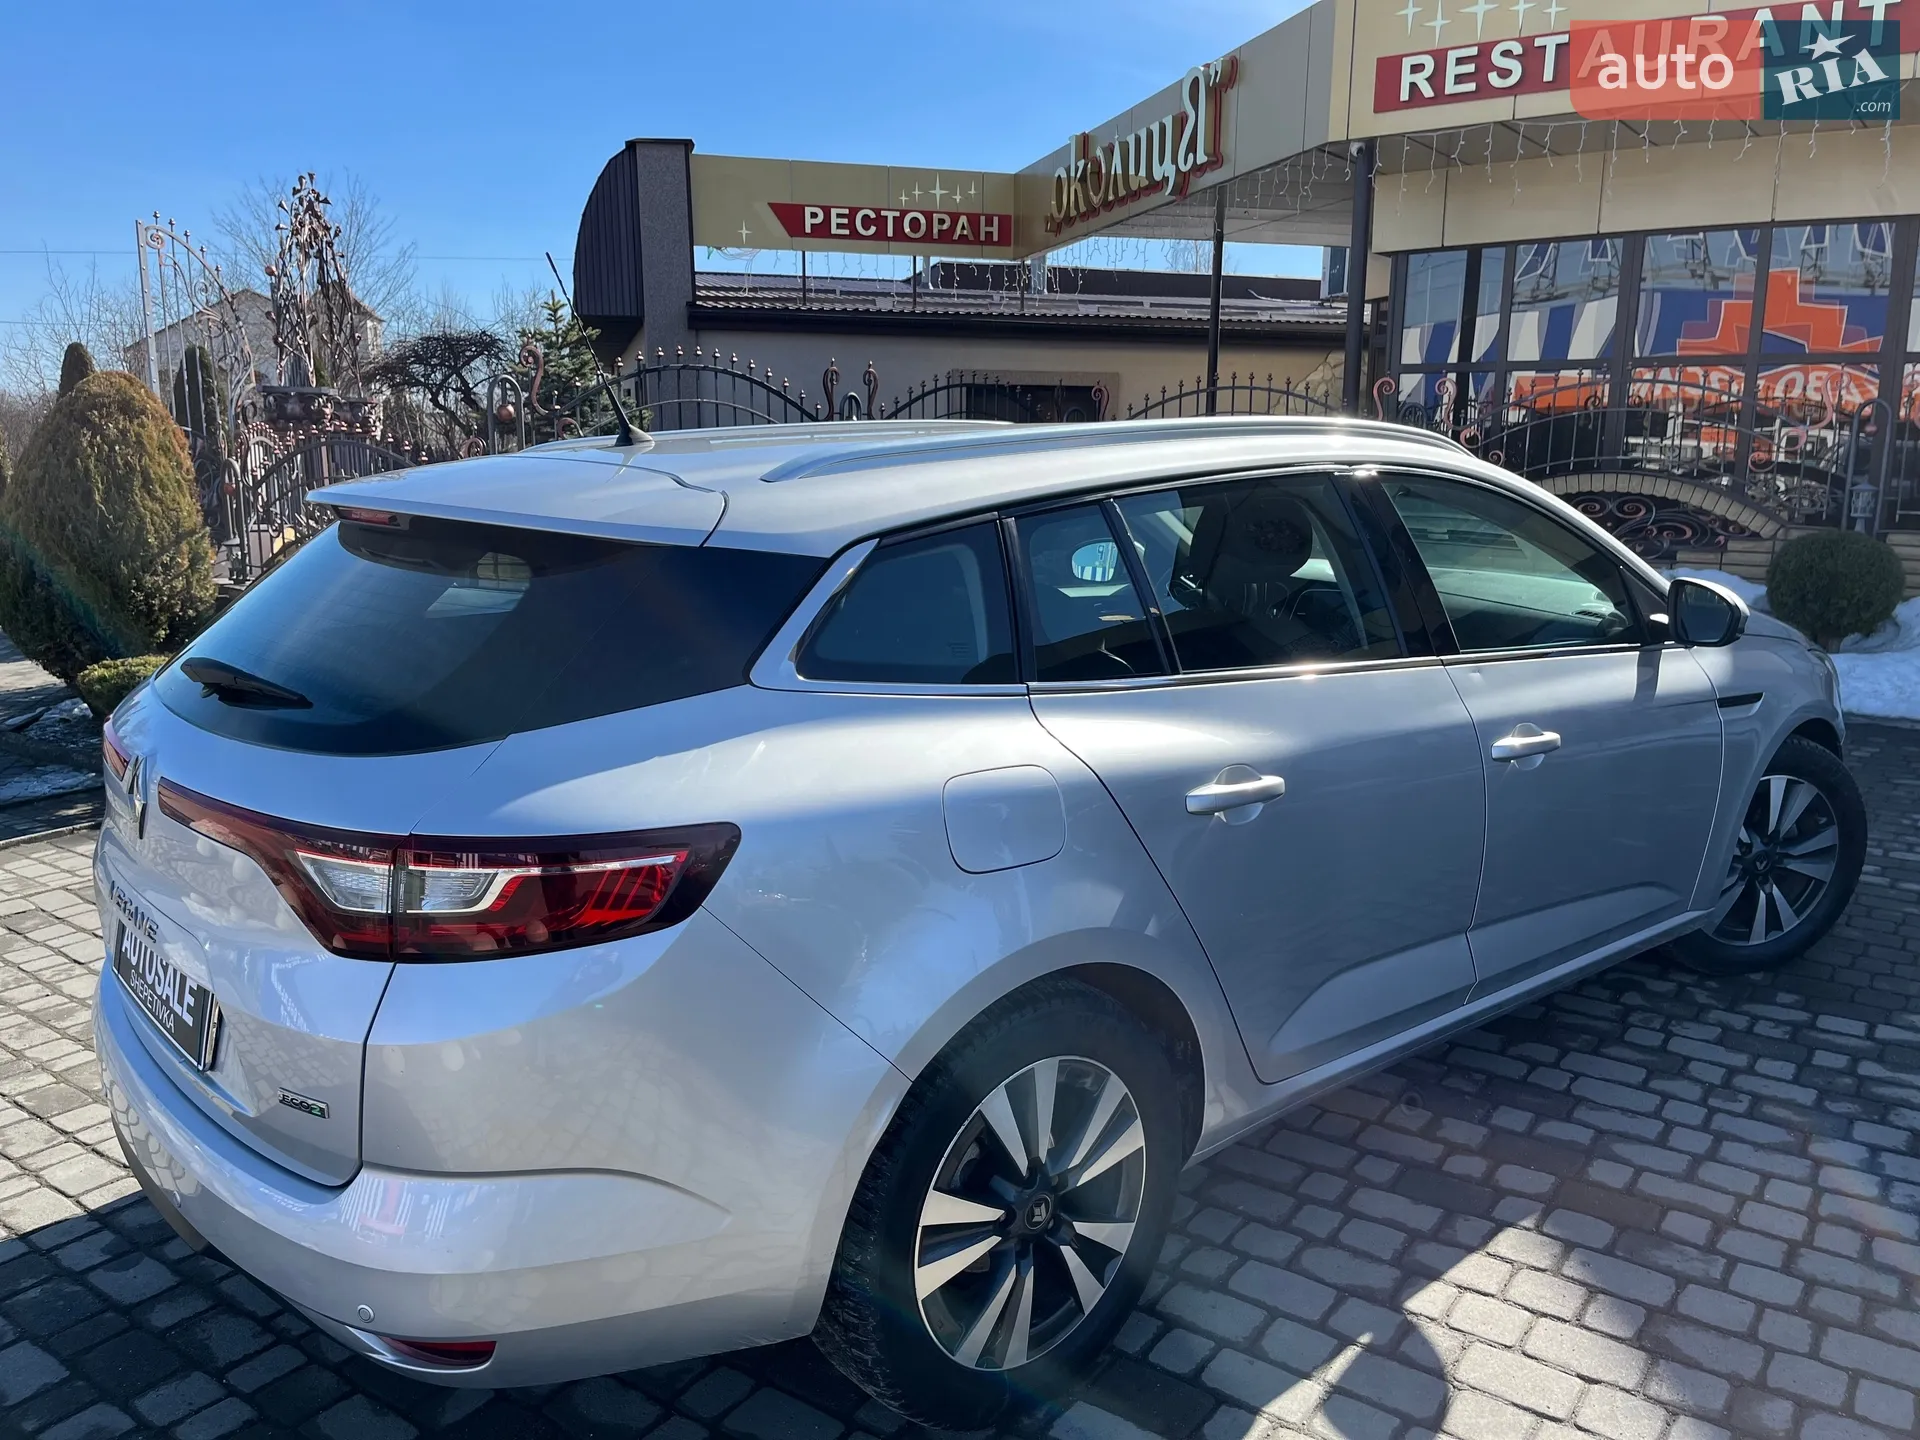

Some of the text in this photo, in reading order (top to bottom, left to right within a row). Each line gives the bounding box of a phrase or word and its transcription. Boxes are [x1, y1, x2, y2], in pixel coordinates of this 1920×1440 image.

[1399, 0, 1902, 102] RESTAURANT
[803, 205, 1000, 243] РЕСТОРАН
[122, 927, 198, 1027] AUTOSALE
[130, 969, 175, 1034] SHEPETIVKA
